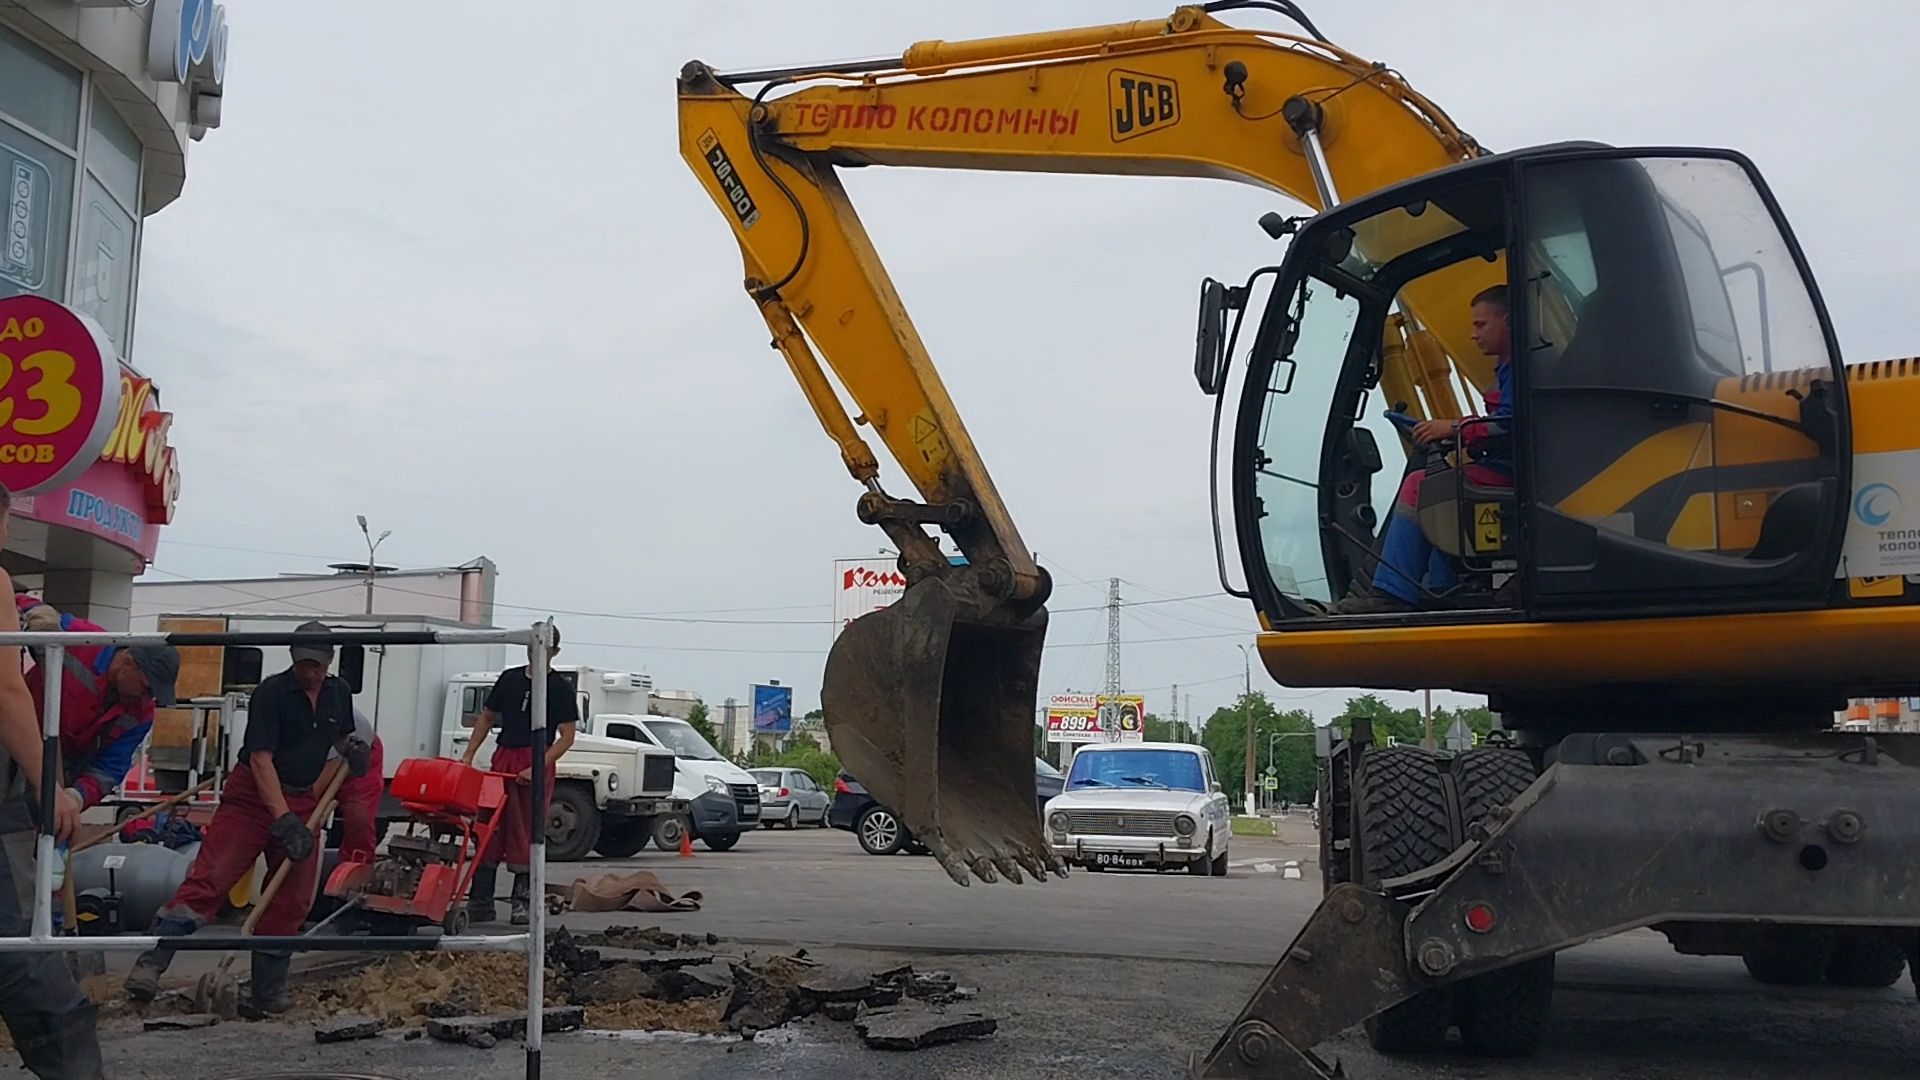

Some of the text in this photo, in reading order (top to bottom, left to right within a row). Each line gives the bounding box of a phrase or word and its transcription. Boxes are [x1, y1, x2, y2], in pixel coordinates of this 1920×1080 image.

[794, 103, 1080, 136] ТЕПЛО КОЛОМНЫ
[1115, 77, 1174, 134] JCB
[0, 349, 83, 437] 3
[1050, 695, 1095, 704] ОФИСМАГ
[1060, 716, 1087, 730] 899
